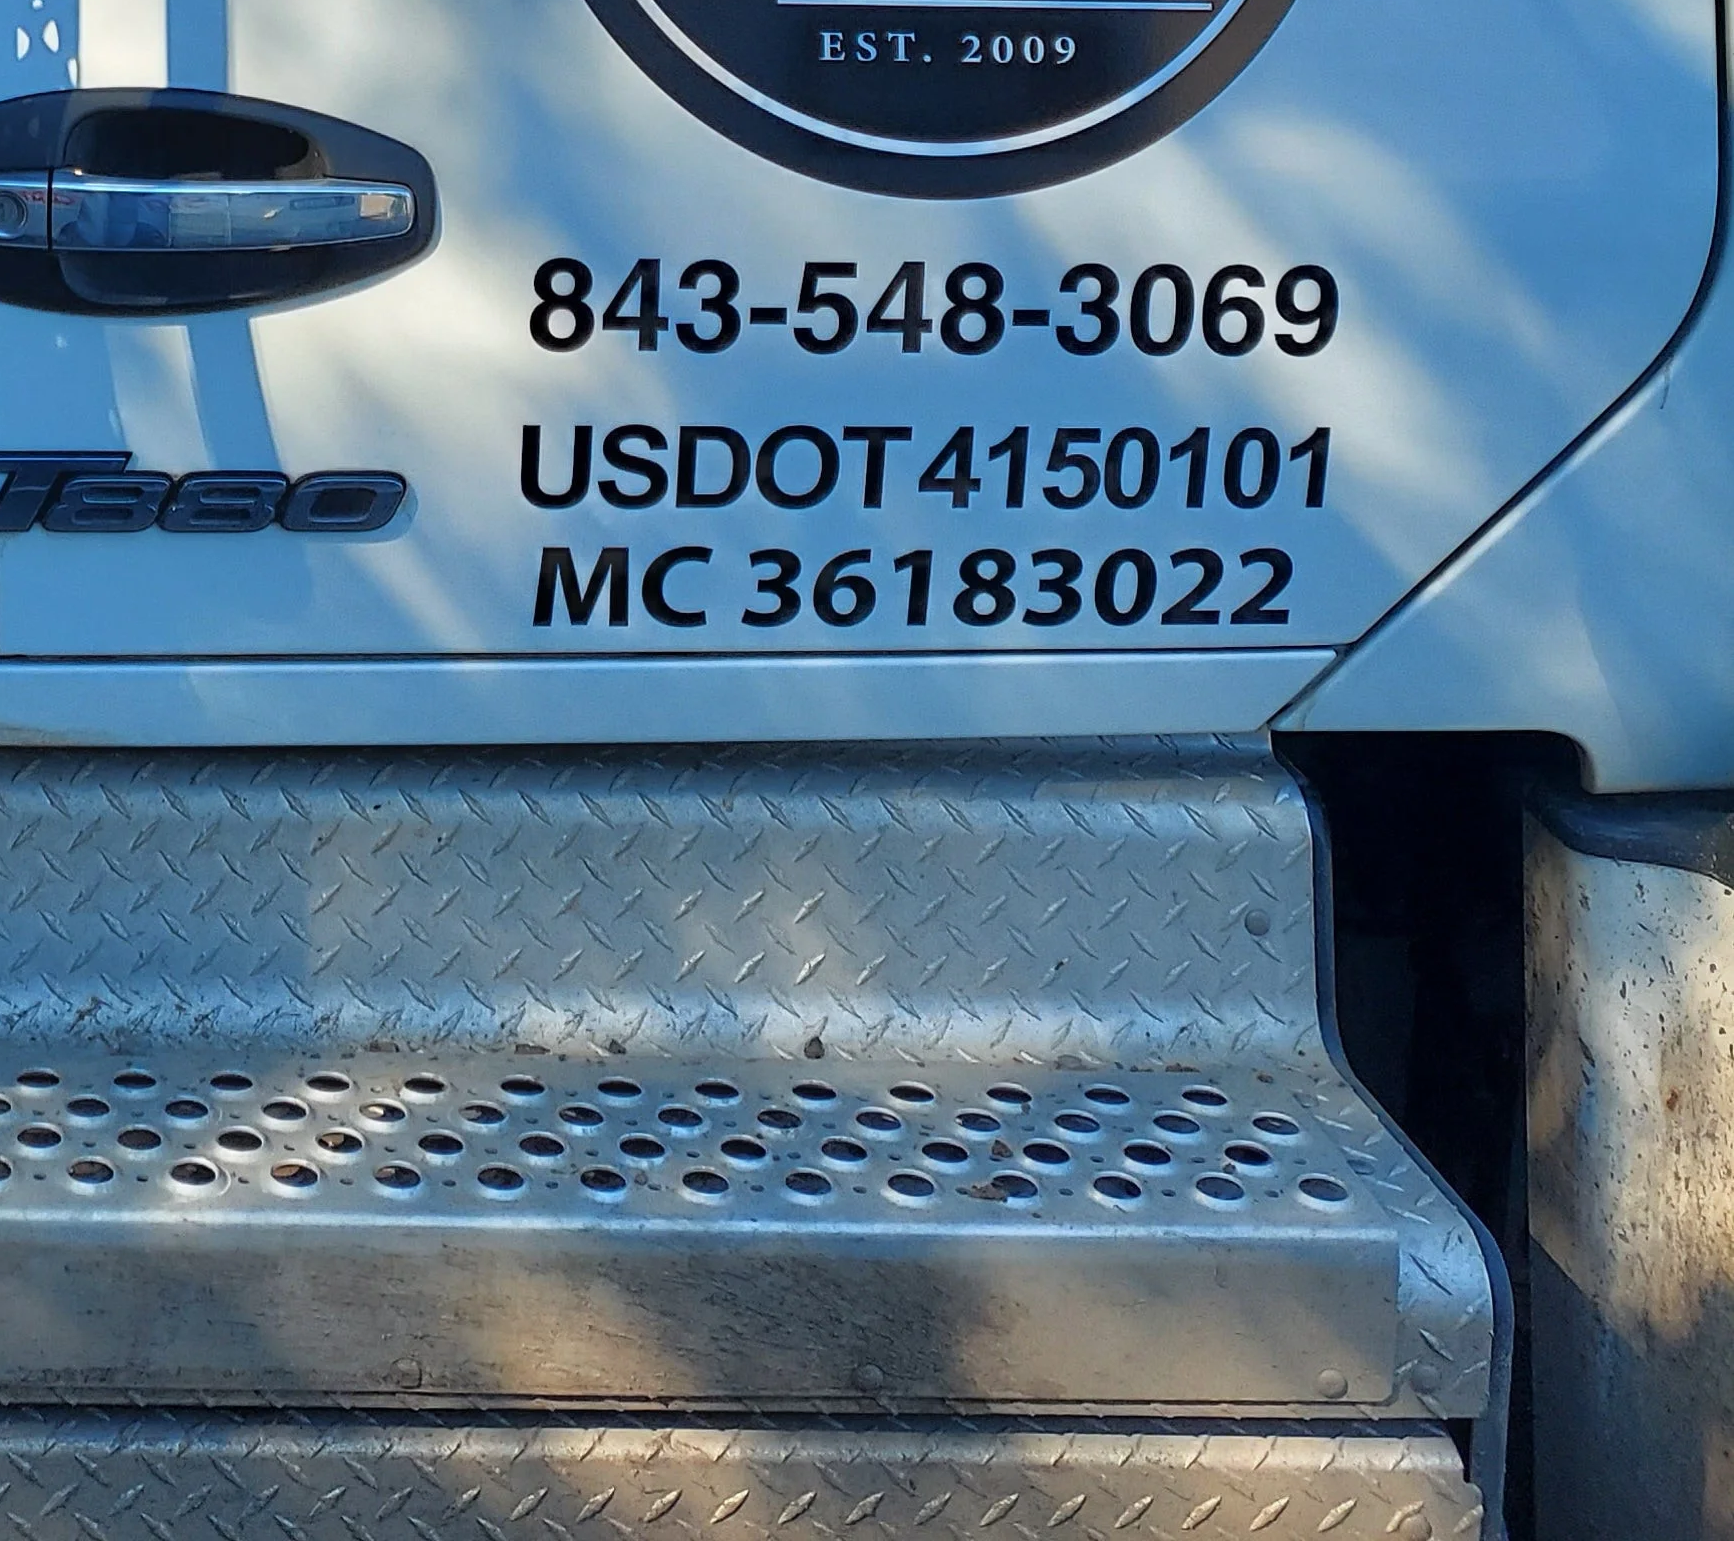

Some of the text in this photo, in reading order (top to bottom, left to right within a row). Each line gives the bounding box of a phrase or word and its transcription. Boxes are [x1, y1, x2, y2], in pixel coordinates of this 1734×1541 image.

[818, 31, 1079, 66] EST. 2009
[527, 256, 1341, 359] 843-548-3069
[519, 423, 1333, 511] USDOT 4150101
[532, 545, 1296, 629] MC 36183022
